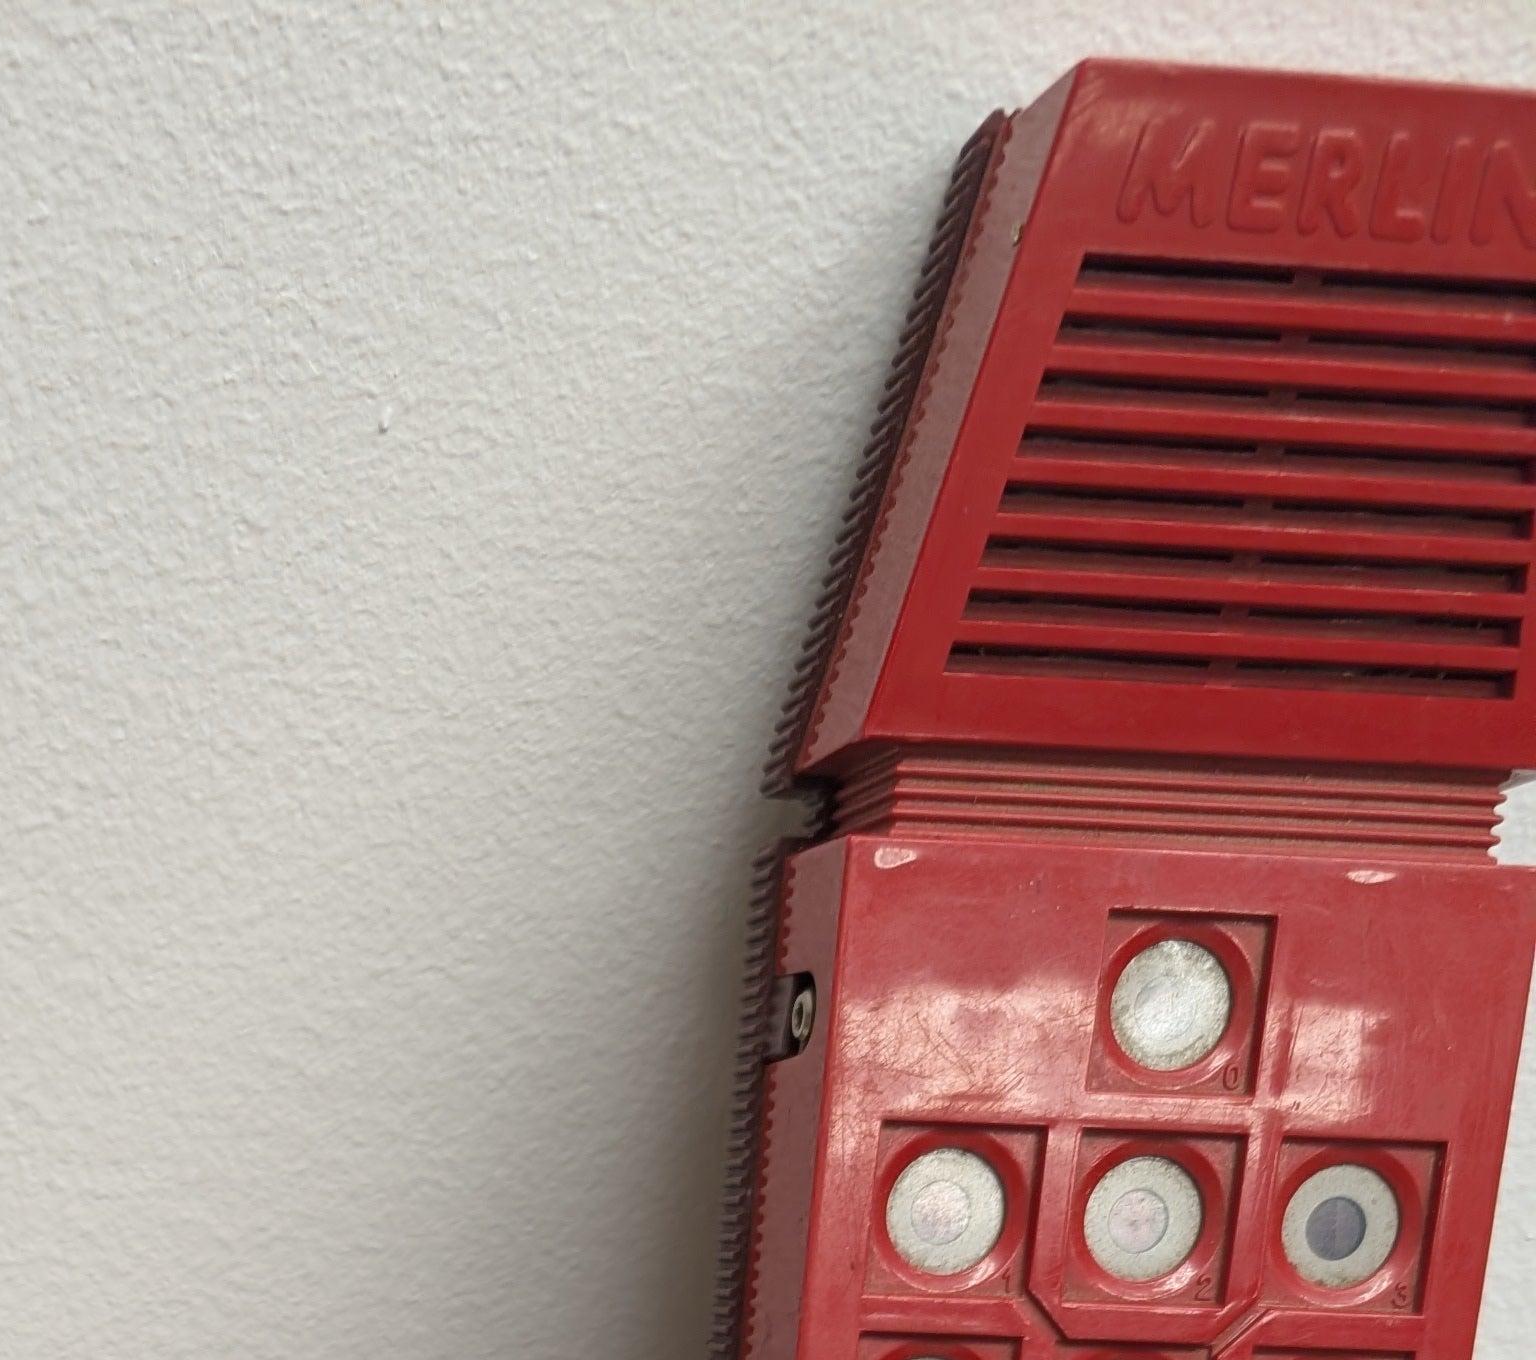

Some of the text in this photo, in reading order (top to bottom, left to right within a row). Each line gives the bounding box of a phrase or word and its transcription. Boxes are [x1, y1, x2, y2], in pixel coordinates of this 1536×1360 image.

[1222, 1064, 1238, 1091] 0
[1001, 1271, 1011, 1293] 1
[1194, 1276, 1212, 1301] 2
[1392, 1282, 1409, 1310] 3
